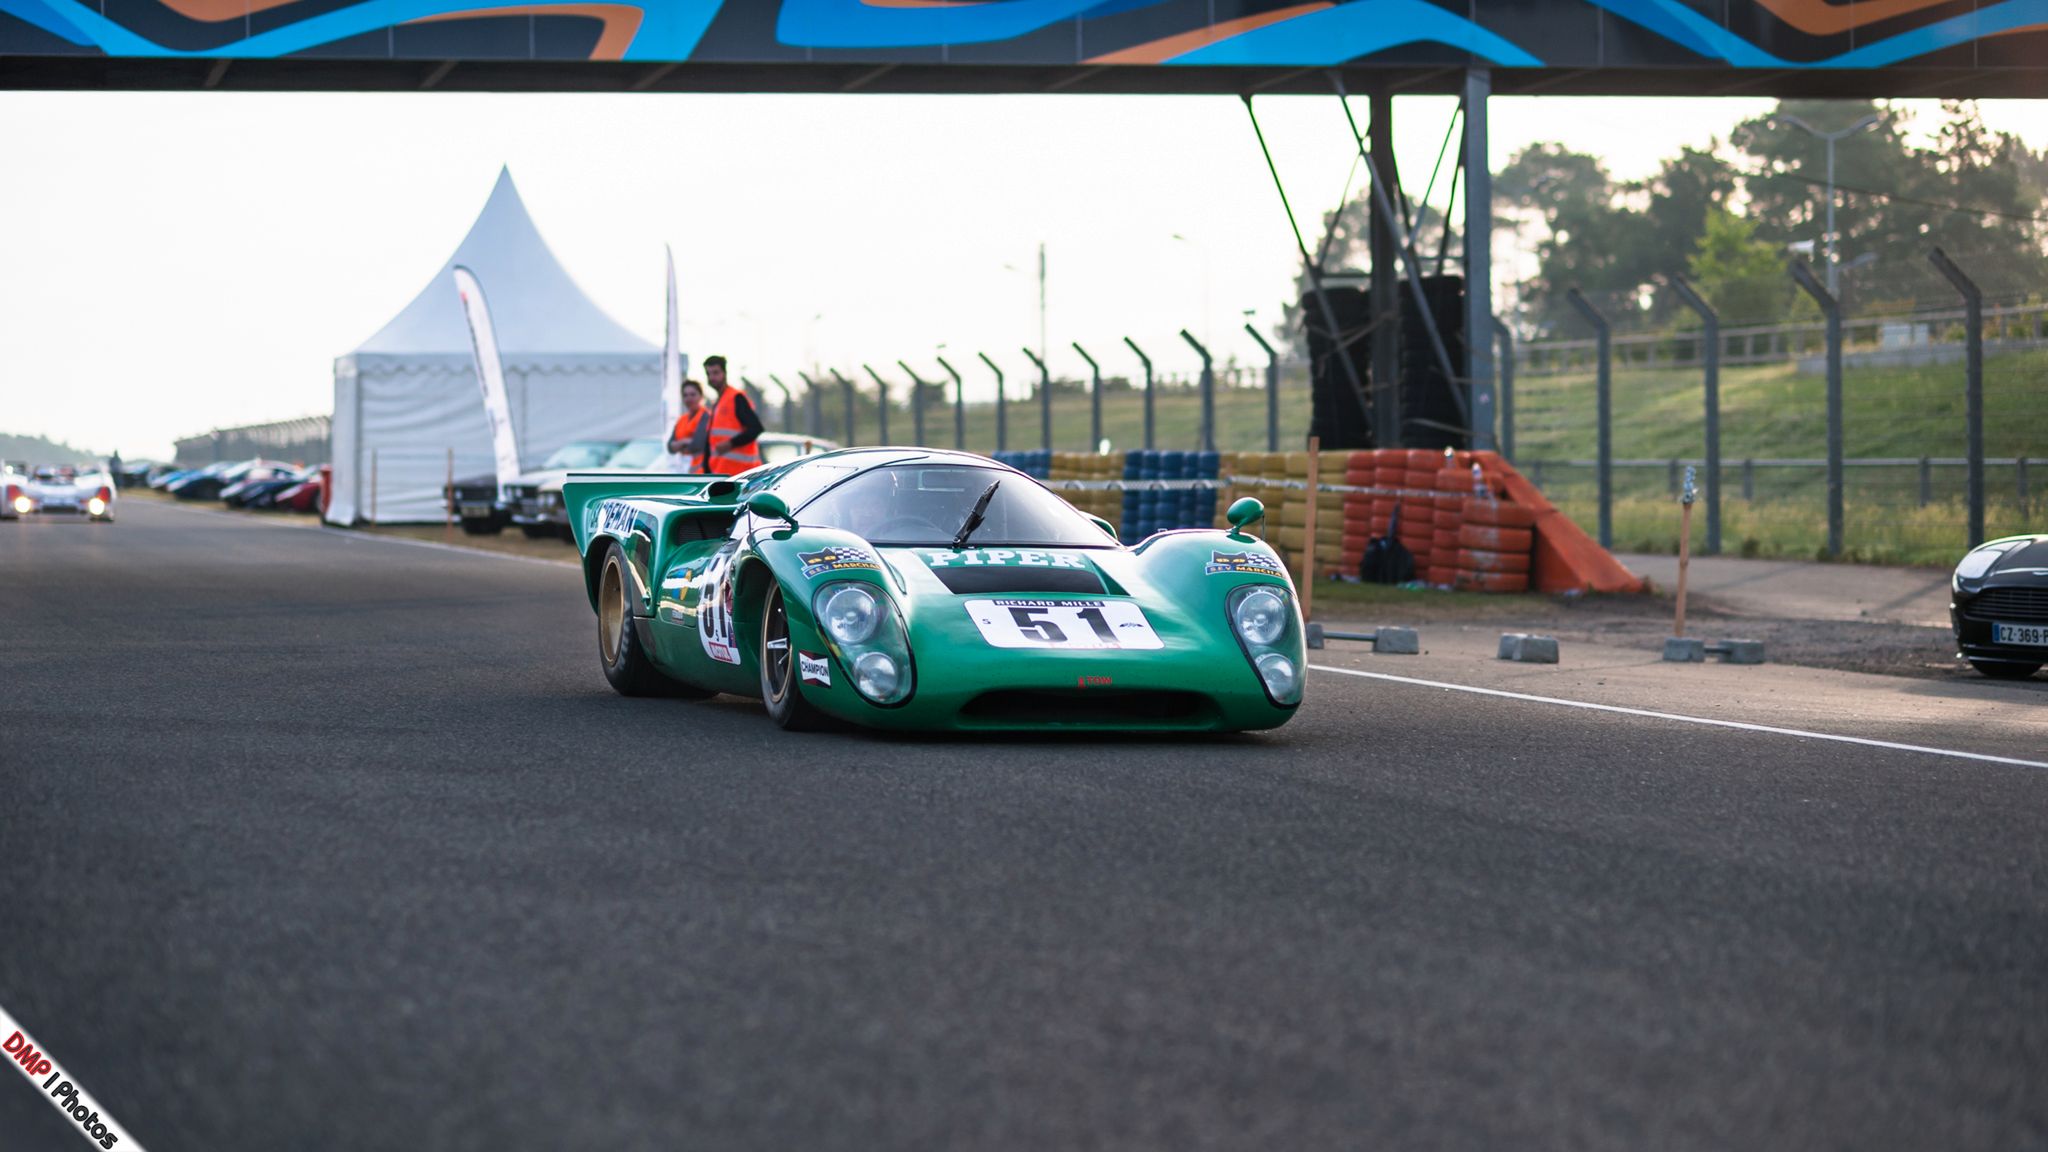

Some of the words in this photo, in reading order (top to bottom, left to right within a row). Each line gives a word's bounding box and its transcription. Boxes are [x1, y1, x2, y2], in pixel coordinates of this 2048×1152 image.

[926, 549, 1086, 569] PIPER
[1065, 600, 1103, 608] MILLE
[1007, 607, 1120, 643] 51
[801, 660, 829, 677] CHAMPION
